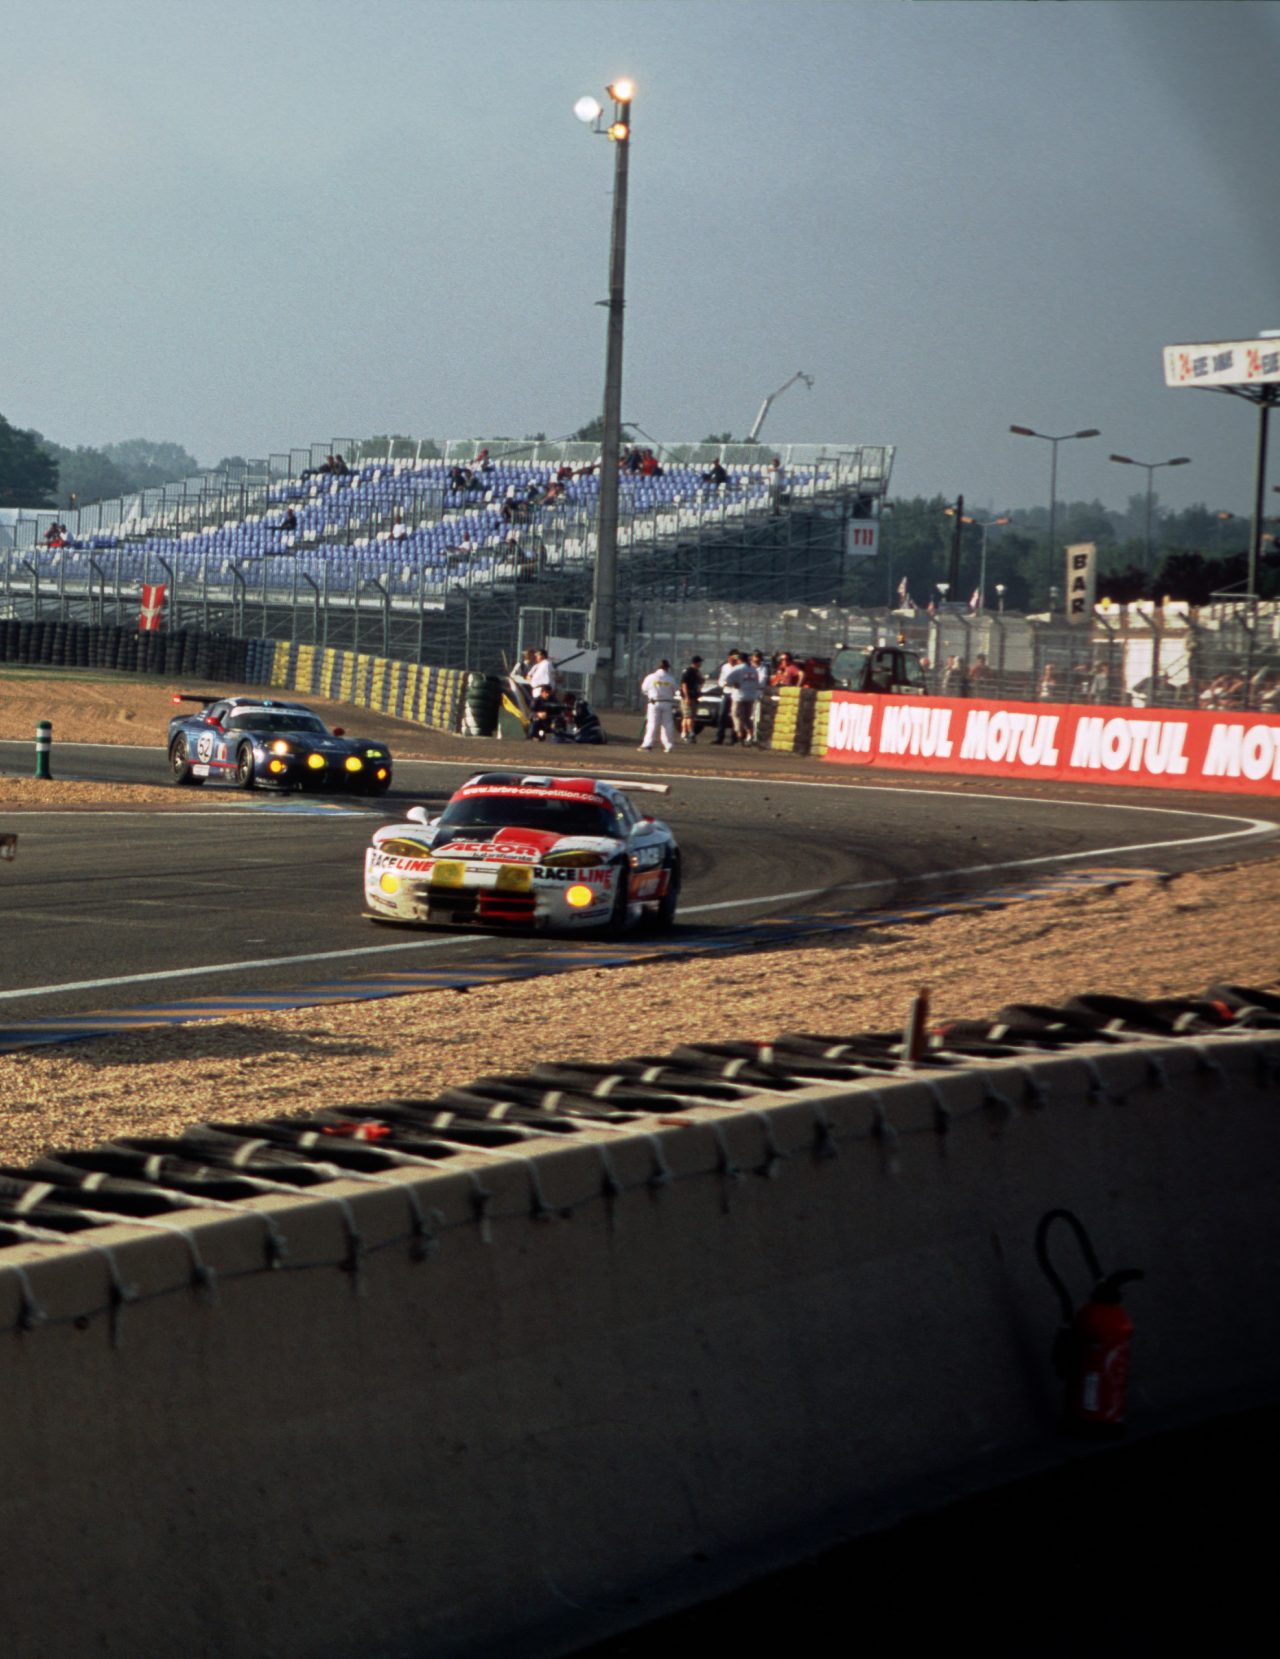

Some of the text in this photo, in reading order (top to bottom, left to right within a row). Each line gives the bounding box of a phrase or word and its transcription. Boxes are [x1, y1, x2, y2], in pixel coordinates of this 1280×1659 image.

[1072, 553, 1089, 613] BAR
[879, 705, 953, 758] MOTUL
[960, 710, 1059, 766] MOTUL
[1070, 716, 1188, 774] MOTUL
[441, 842, 537, 857] ACCOR
